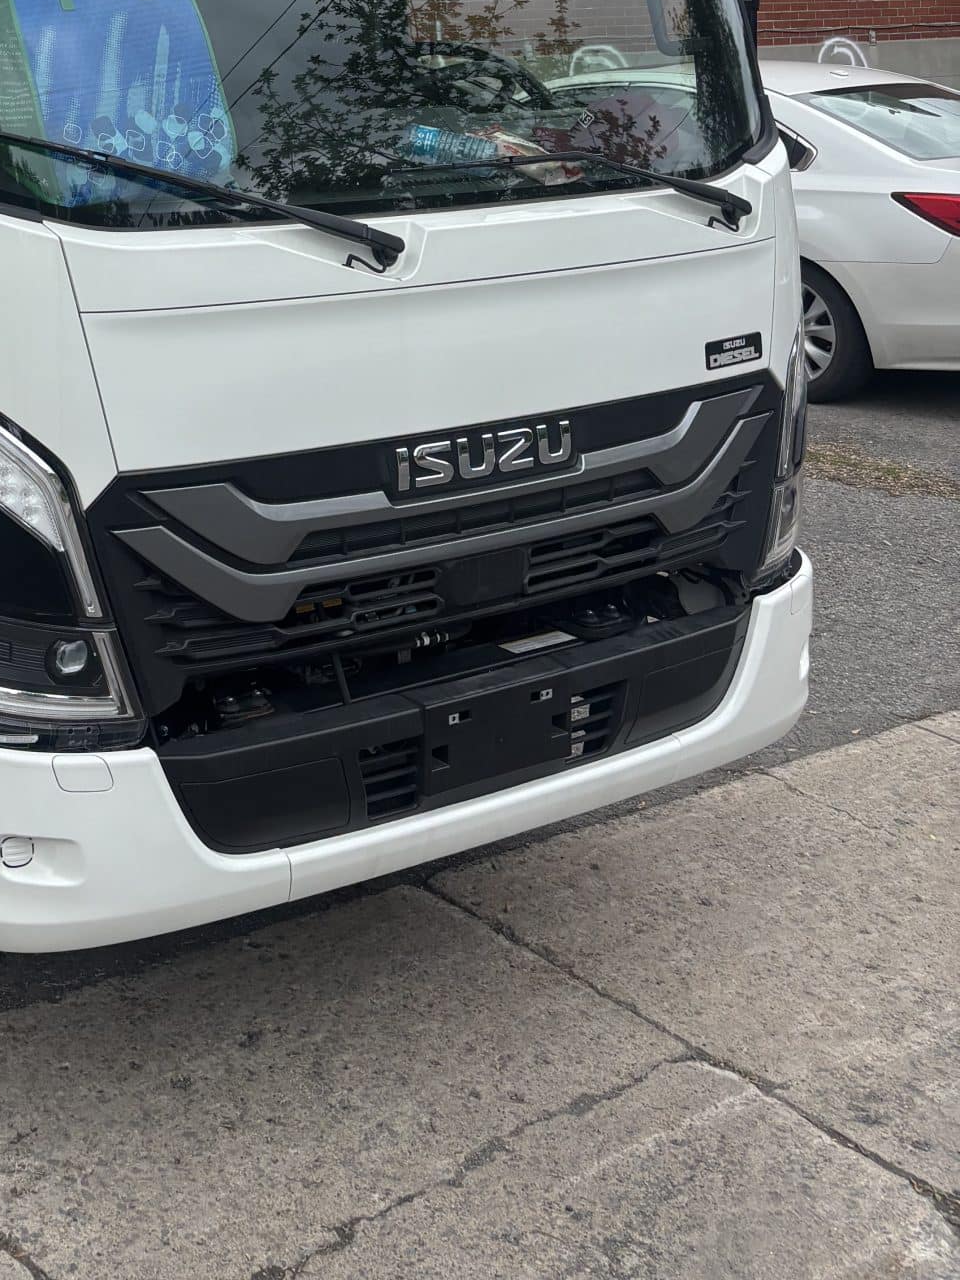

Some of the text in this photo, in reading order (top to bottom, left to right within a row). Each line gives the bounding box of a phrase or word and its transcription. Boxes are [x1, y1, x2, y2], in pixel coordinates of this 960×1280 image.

[722, 337, 746, 350] ISUZU
[709, 346, 760, 368] DIESEL
[395, 420, 571, 492] ISUZU
